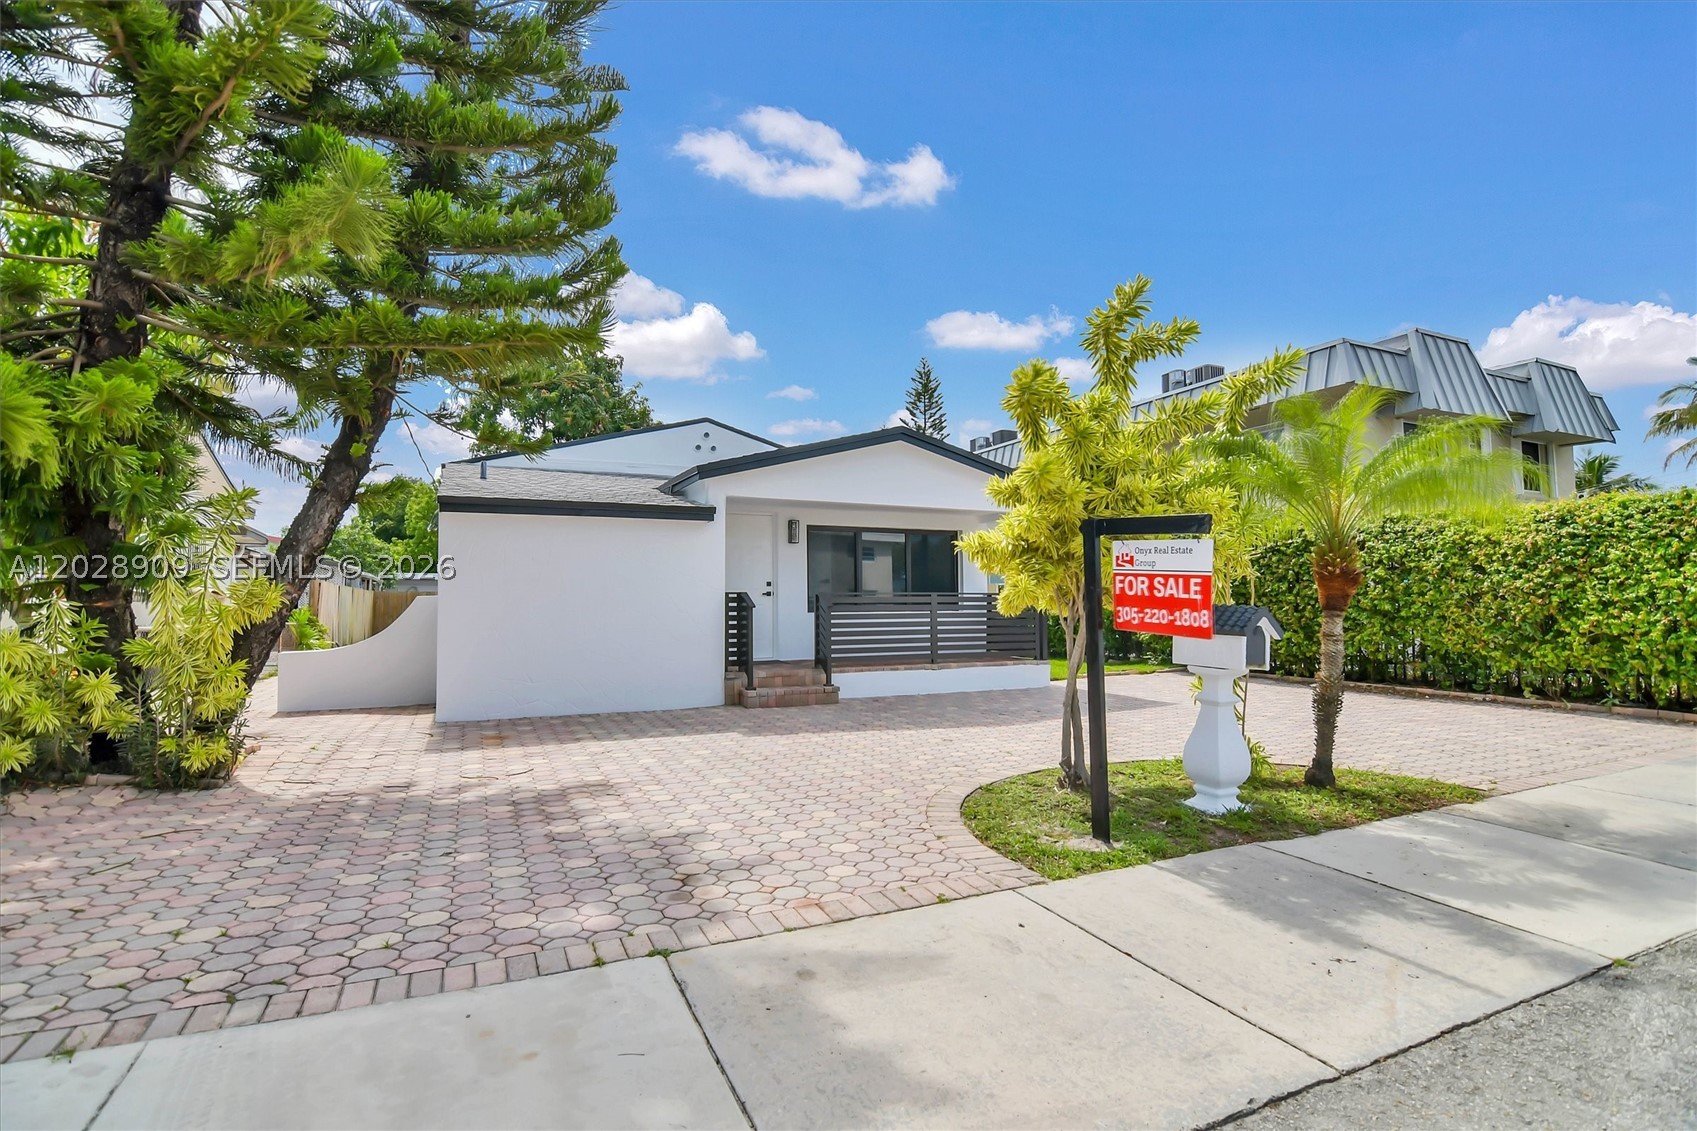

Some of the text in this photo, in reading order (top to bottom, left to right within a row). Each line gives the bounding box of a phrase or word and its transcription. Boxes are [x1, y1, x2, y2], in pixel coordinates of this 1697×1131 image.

[1134, 546, 1194, 556] Onyx Real Estate
[1134, 559, 1157, 569] Group
[1115, 576, 1202, 600] FOR SALE
[1116, 606, 1210, 628] 305-220-1808
